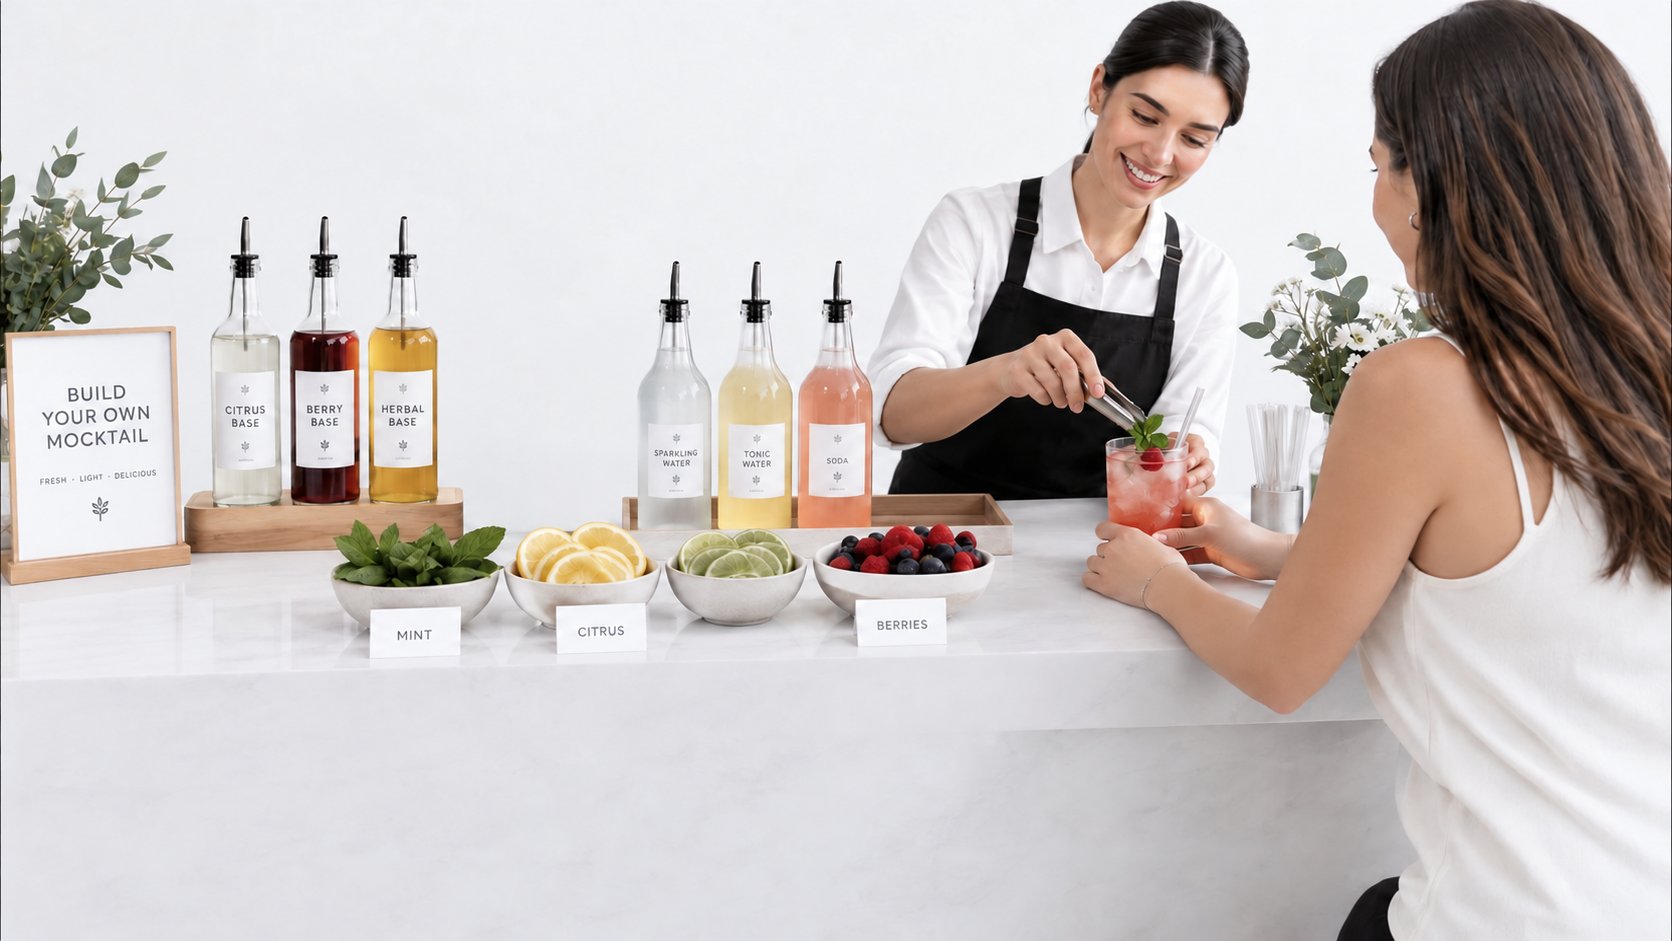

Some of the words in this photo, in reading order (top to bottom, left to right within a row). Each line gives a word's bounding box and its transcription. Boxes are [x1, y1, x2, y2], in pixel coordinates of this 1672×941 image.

[67, 384, 126, 403] BUILD
[224, 404, 266, 416] CITRUS
[306, 404, 343, 415] BERRY
[381, 404, 425, 414] HERBAL
[41, 408, 97, 427] YOUR
[103, 405, 150, 423] OWN
[231, 417, 260, 428] BASE
[310, 417, 339, 427] BASE
[388, 417, 417, 427] BASE
[46, 427, 149, 450] MOCKTAIL
[653, 448, 698, 458] SPARKLING
[743, 449, 771, 459] TONIC
[662, 459, 691, 468] WATER
[742, 459, 772, 468] WATER
[826, 457, 849, 465] SODA
[39, 476, 67, 486] FRESH
[79, 473, 104, 483] LIGHT
[114, 468, 157, 480] DELICIOUS
[876, 619, 928, 631] BERRIES
[397, 629, 433, 641] MINT
[577, 625, 625, 638] CITRUS
